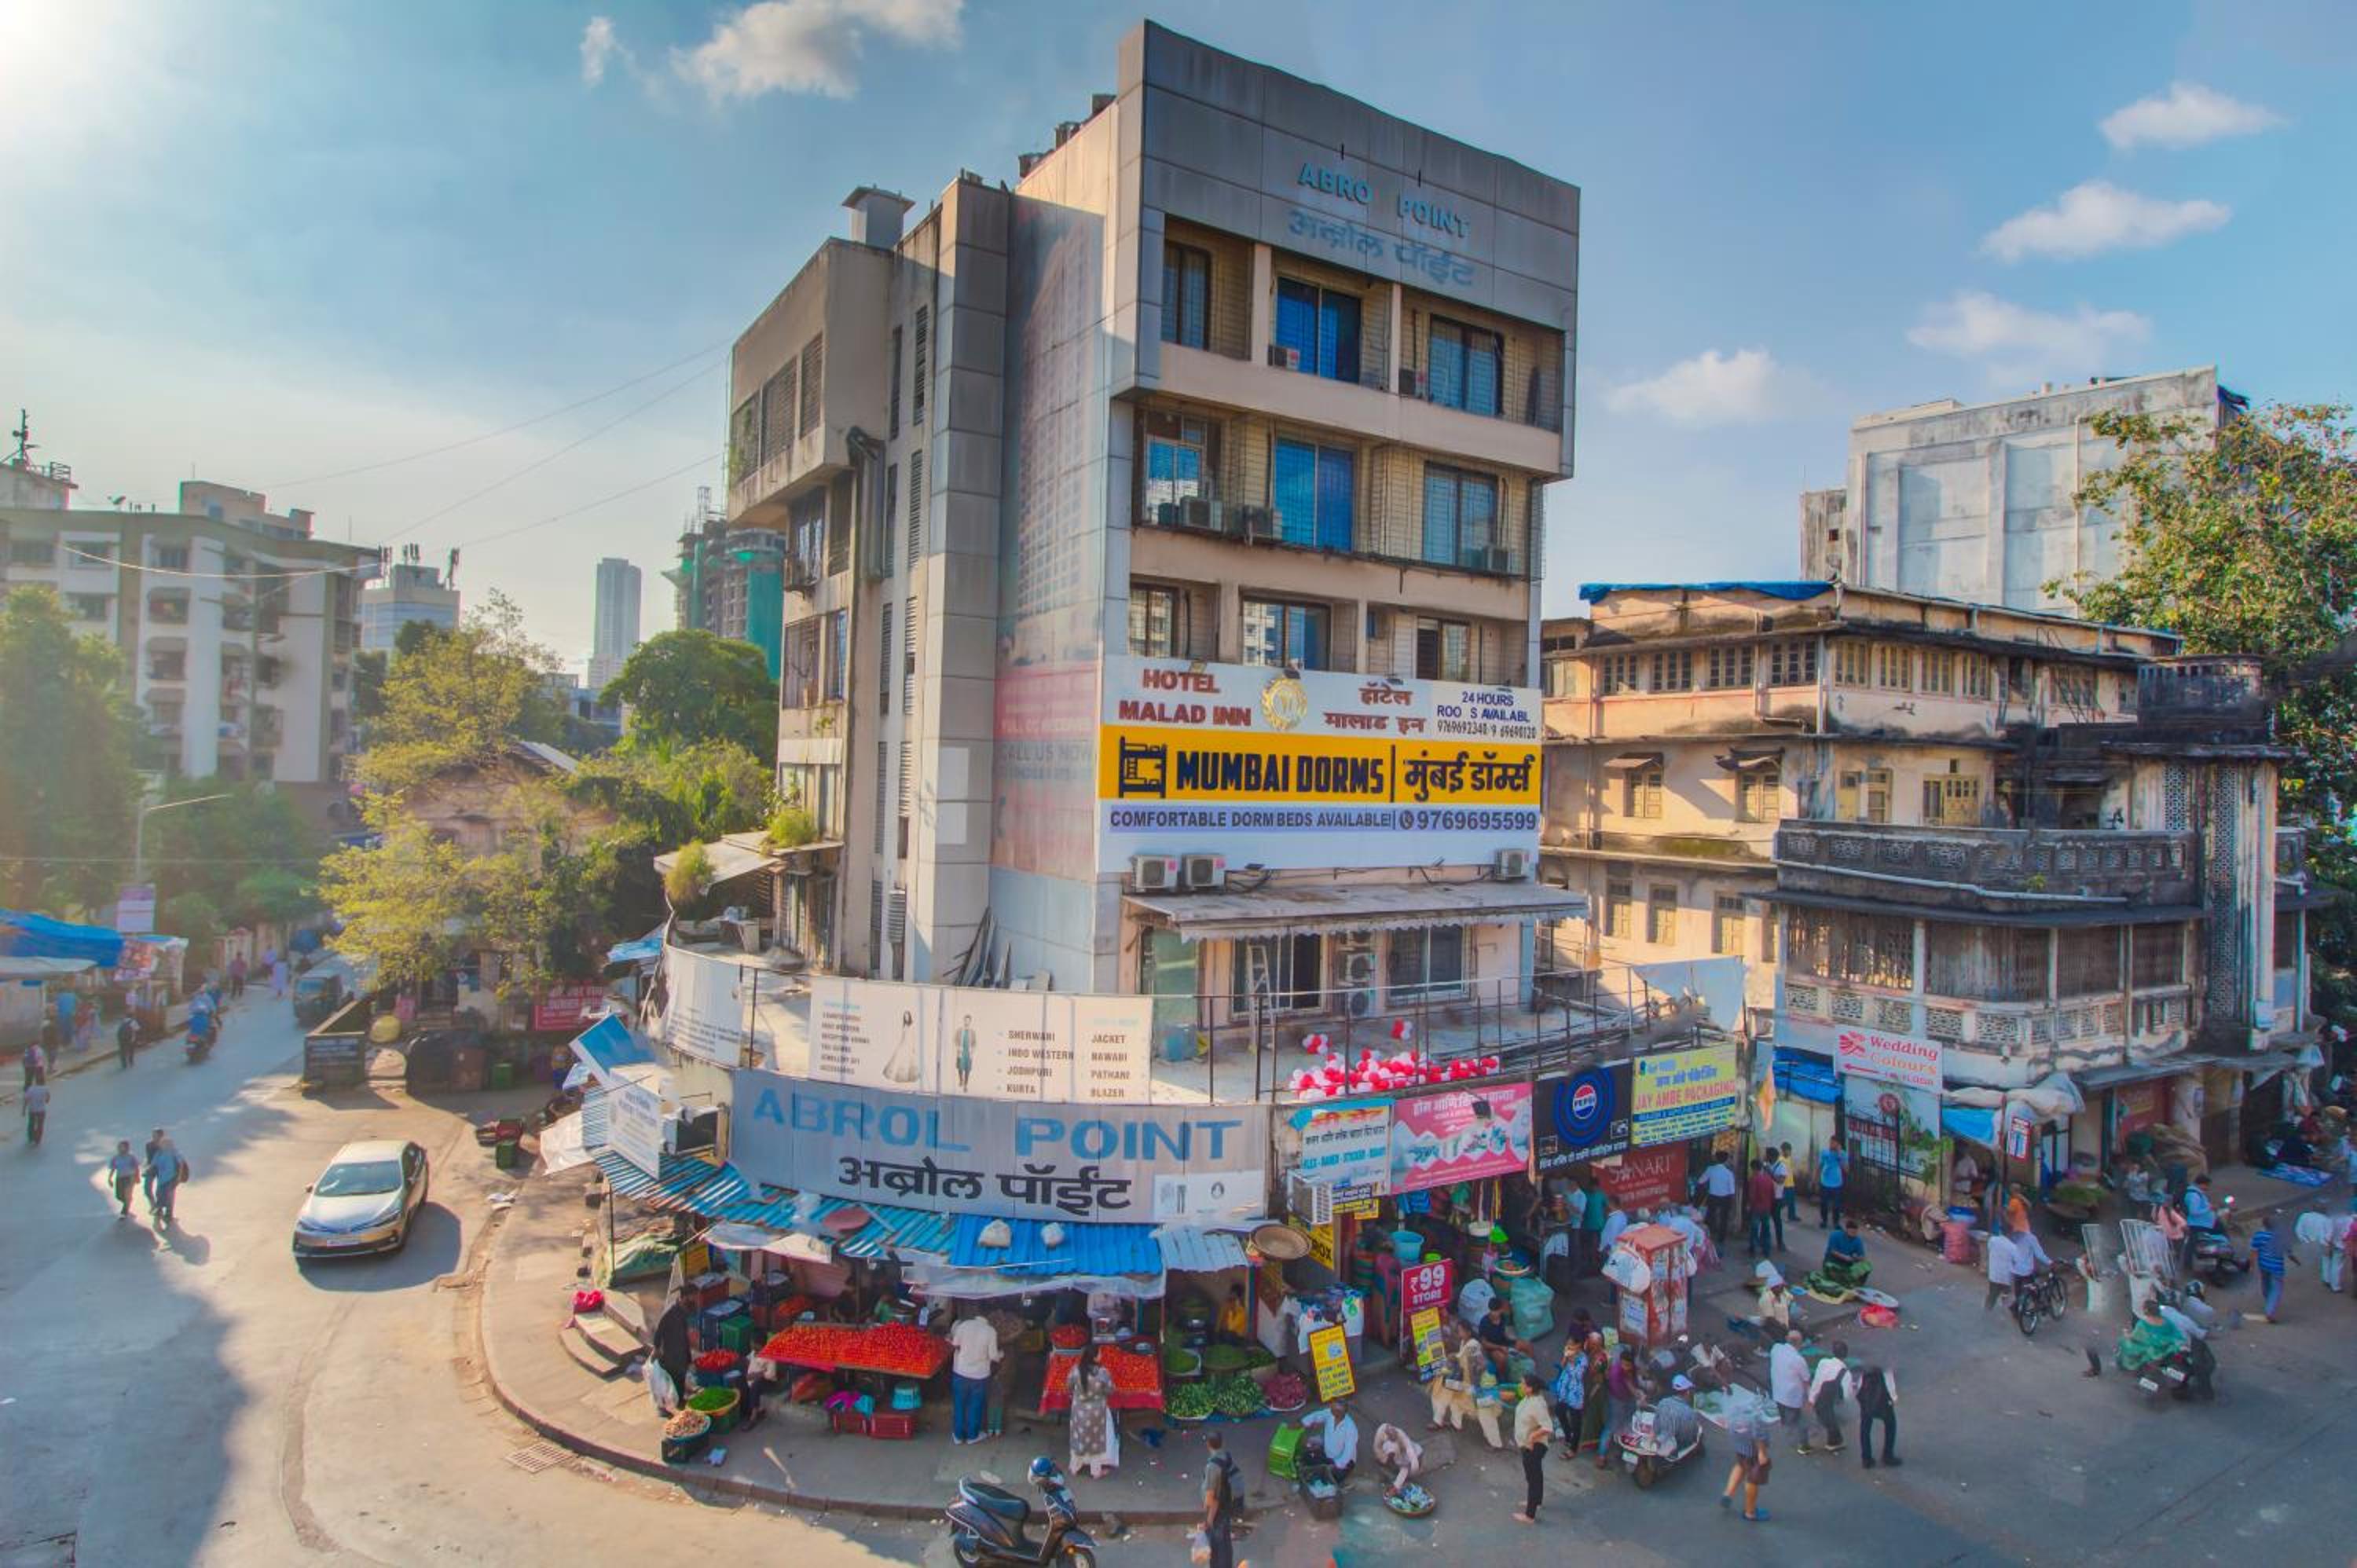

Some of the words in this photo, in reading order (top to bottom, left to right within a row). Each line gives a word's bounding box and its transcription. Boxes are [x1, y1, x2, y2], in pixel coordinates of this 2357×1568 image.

[1398, 193, 1470, 240] POINT
[1142, 669, 1221, 693] HOTEL
[1358, 682, 1413, 705] हॉटेल
[1462, 691, 1475, 703] 24
[1477, 693, 1514, 706] HOURS
[1118, 700, 1206, 724] MALAD
[1212, 705, 1252, 726] INN
[1395, 715, 1428, 735] इन
[1176, 750, 1289, 792] MUMBAI
[1296, 755, 1384, 794] DORMS
[1402, 749, 1467, 802] मुंबई
[1110, 811, 1226, 828] COMFORTABLE
[1231, 811, 1274, 828] DORM
[1274, 811, 1313, 828] BEDS
[1417, 811, 1538, 831] 9769695599
[1008, 1030, 1055, 1041] SHERWANI
[1091, 1034, 1126, 1044] JACKET
[1008, 1047, 1029, 1057] INDO
[1032, 1049, 1074, 1061] WESTERN
[1870, 1035, 1938, 1061] Wedding
[1006, 1083, 1036, 1094] KURTA
[753, 1086, 971, 1153] ABROL
[1014, 1114, 1244, 1162] POINT
[838, 1154, 985, 1200] अब्रोल
[1413, 1288, 1442, 1305] STORE
